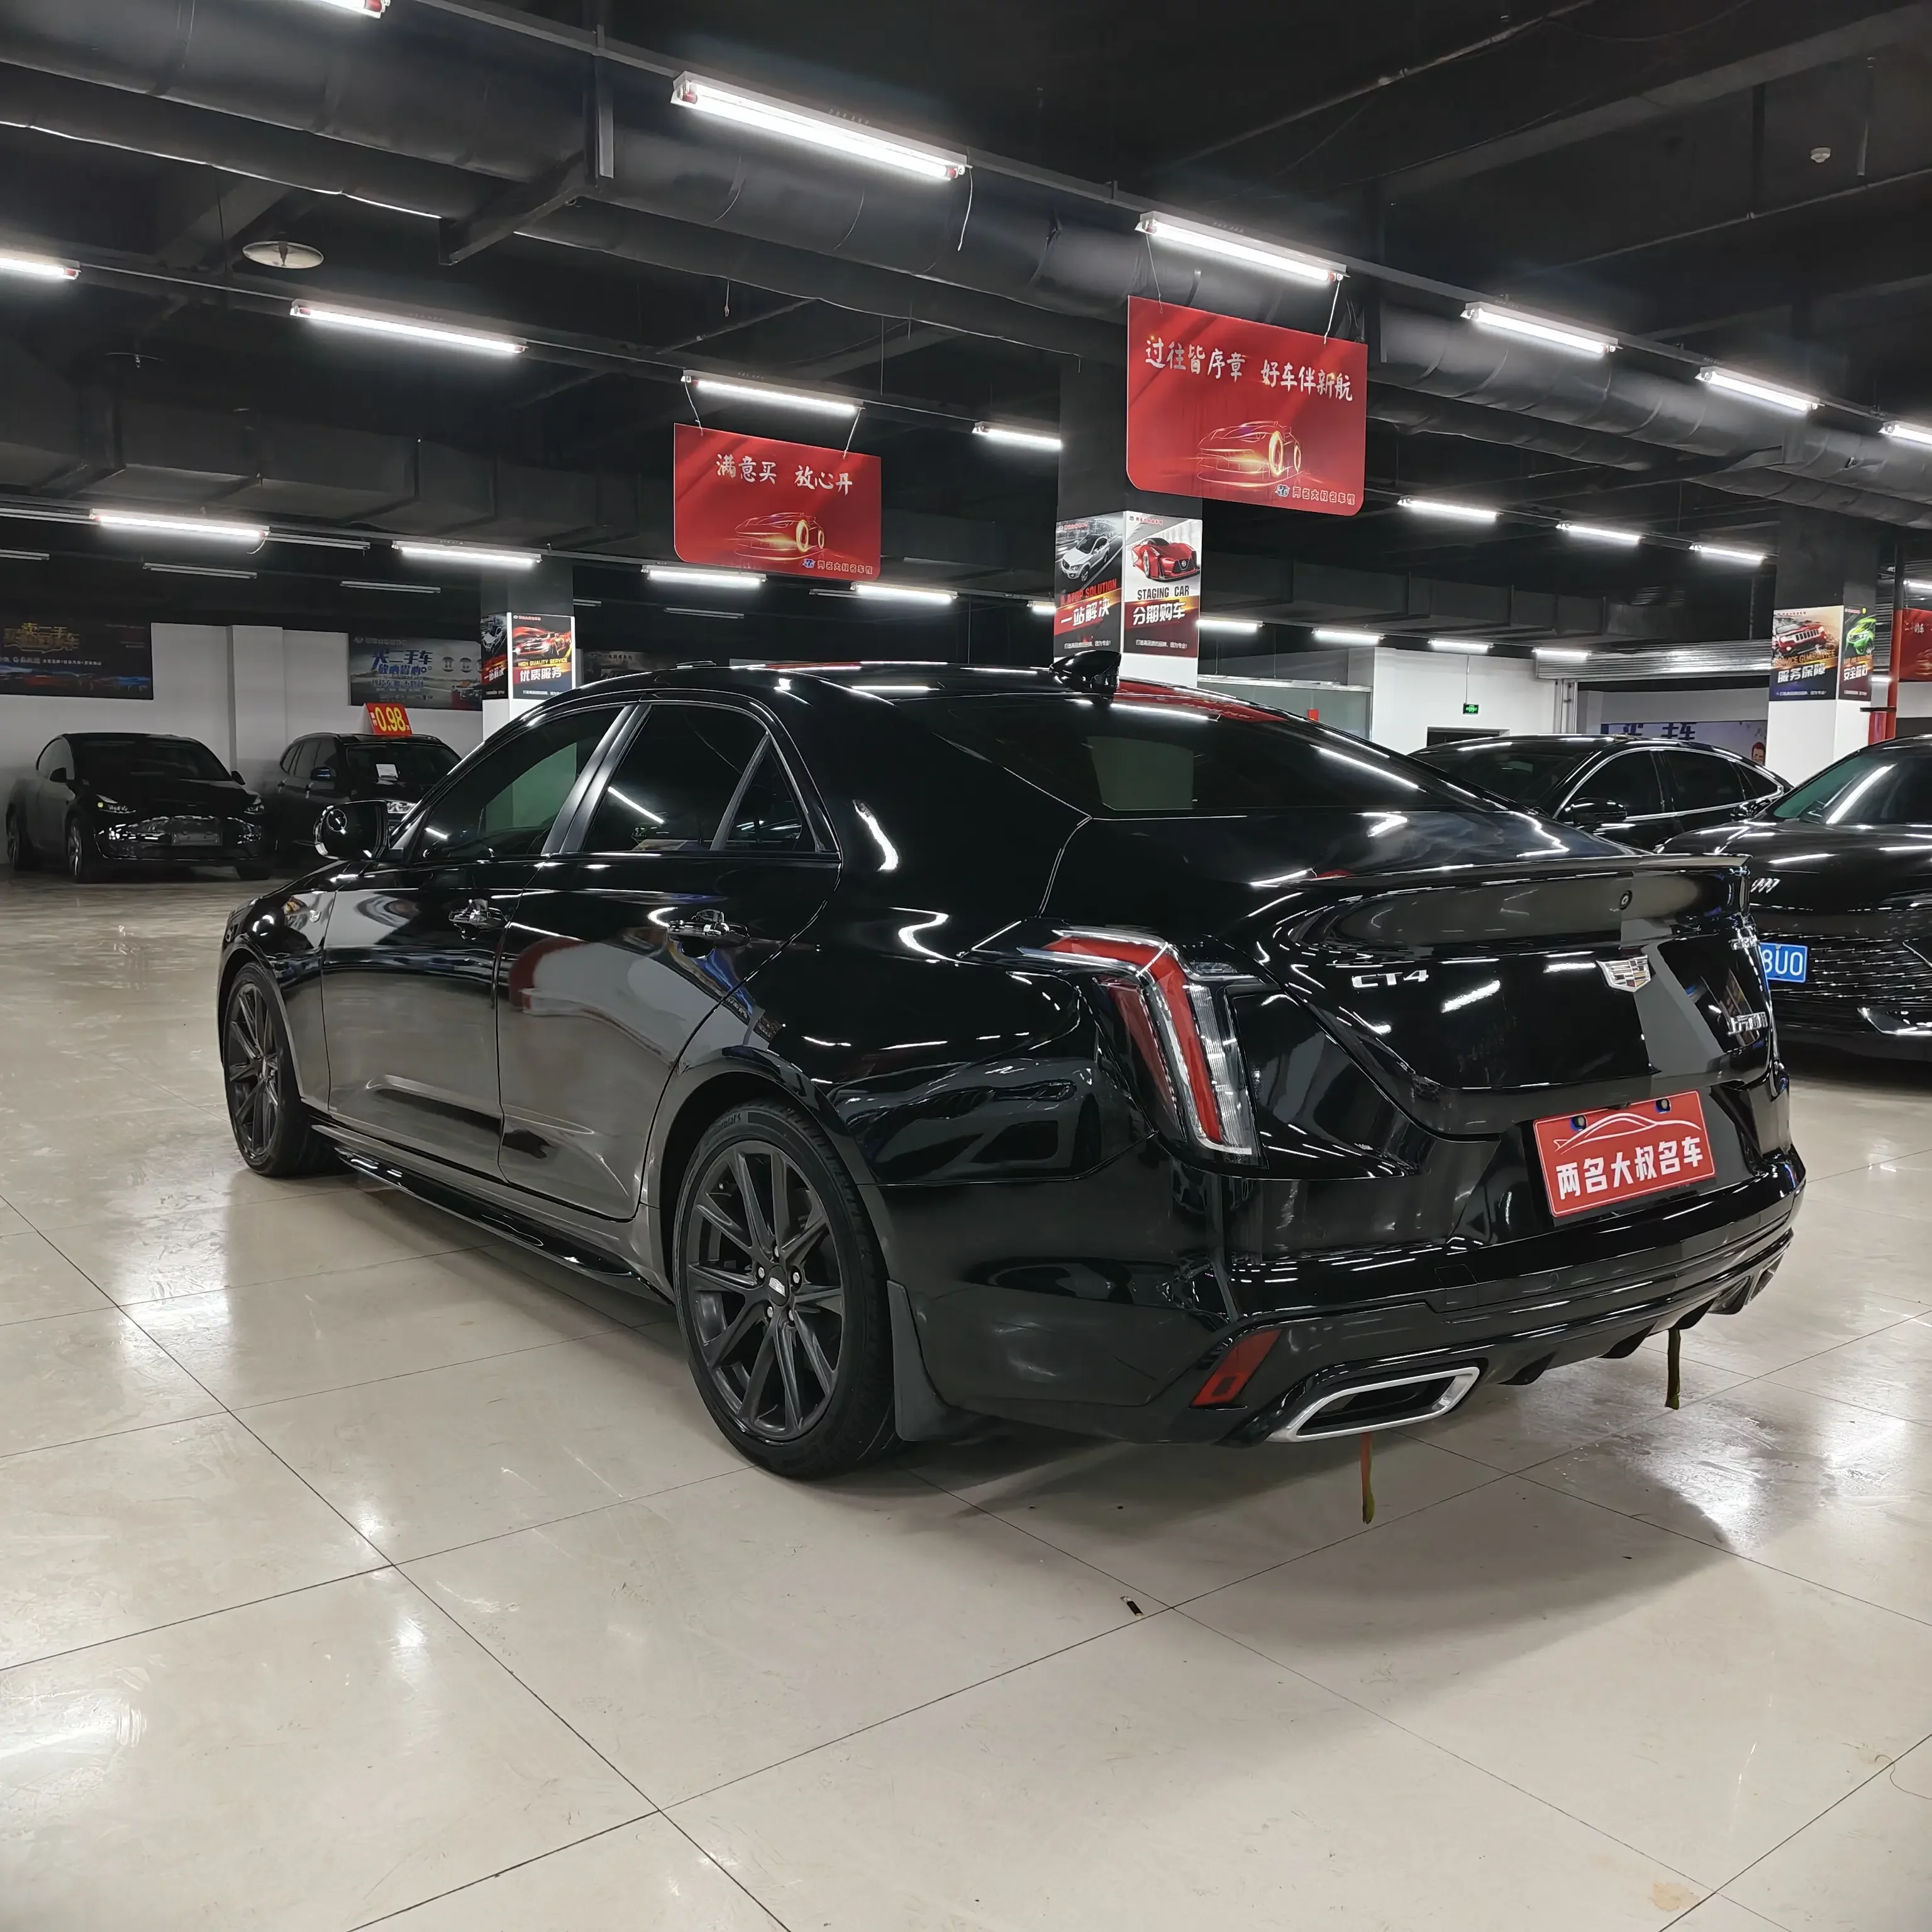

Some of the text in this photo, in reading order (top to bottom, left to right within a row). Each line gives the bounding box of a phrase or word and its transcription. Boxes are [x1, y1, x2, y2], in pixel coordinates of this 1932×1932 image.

[1145, 337, 1353, 401] 过往皆序章 好车伴新航
[716, 453, 853, 496] 满意买 放心开
[1085, 579, 1117, 598] SOLUTION
[1137, 585, 1190, 600] STAGING CAR
[1061, 597, 1111, 626] 一站解决
[1133, 601, 1186, 626] 分期购车
[520, 667, 562, 682] 优质服务
[1777, 662, 1826, 684] 服务保障
[375, 707, 406, 731] 0.98
[1352, 969, 1429, 988] CT4
[1556, 1136, 1703, 1200] 两名大叔名车
